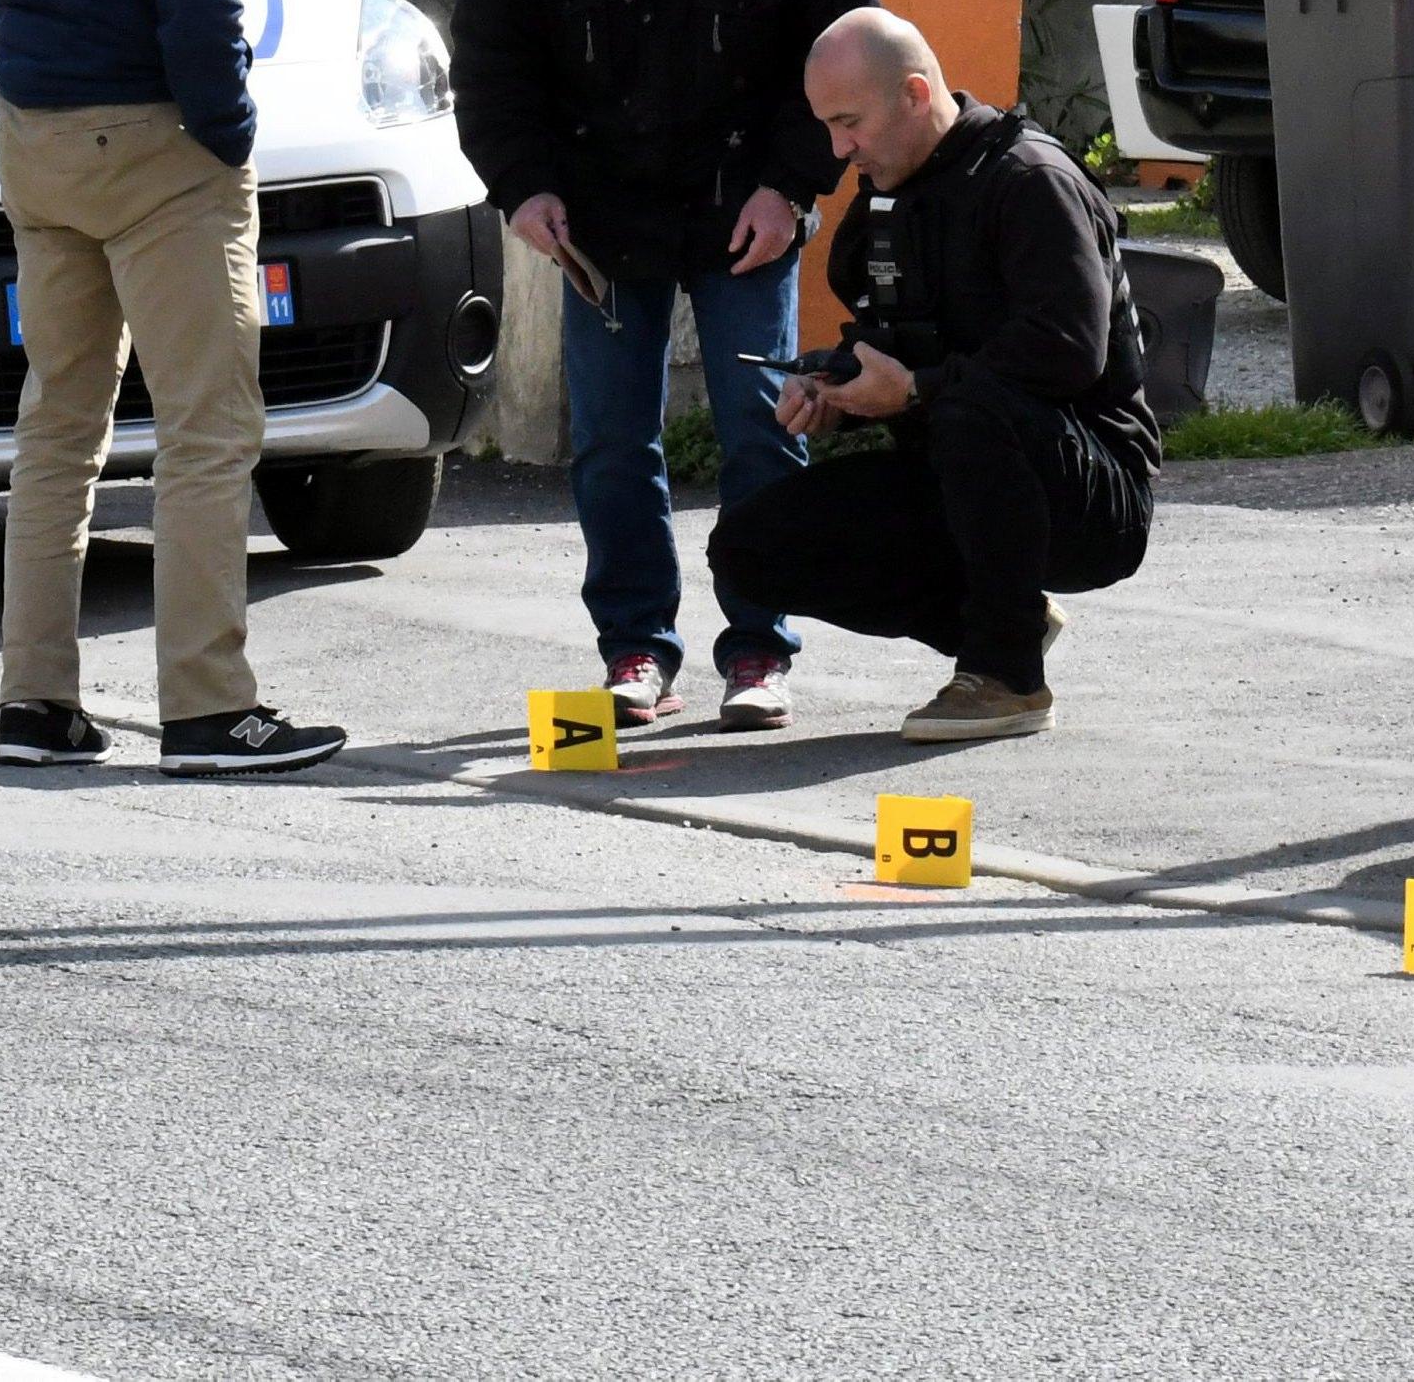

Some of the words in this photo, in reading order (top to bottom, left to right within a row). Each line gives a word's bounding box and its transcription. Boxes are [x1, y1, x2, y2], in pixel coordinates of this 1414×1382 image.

[271, 297, 289, 318] 11
[229, 715, 278, 748] N
[552, 718, 603, 749] A
[536, 745, 544, 753] A
[903, 828, 957, 858] B
